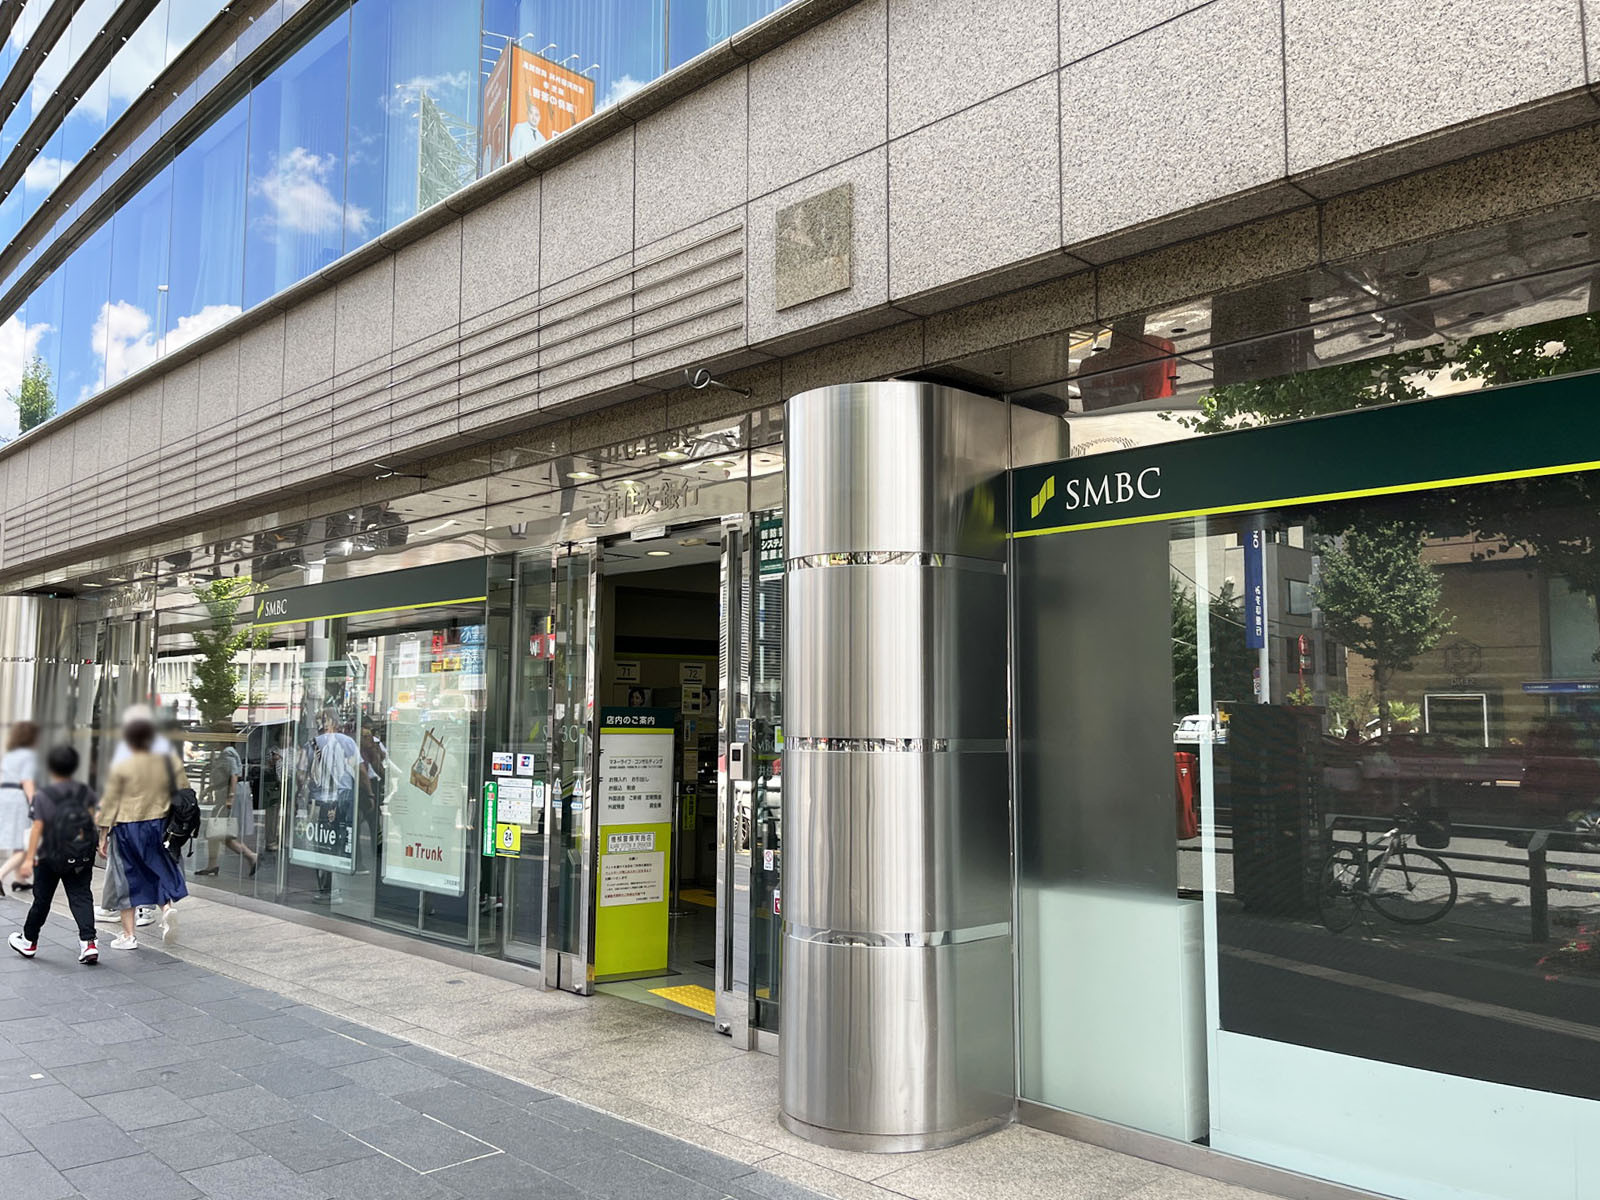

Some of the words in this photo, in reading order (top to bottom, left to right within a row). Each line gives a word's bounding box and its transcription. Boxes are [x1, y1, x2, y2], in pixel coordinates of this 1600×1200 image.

[1065, 467, 1162, 511] SMBC
[265, 598, 288, 617] SMBC
[621, 667, 631, 677] 71
[688, 669, 698, 679] 72
[606, 715, 656, 725] 店内のご案内
[306, 822, 337, 846] Olive
[415, 842, 443, 863] Trunk
